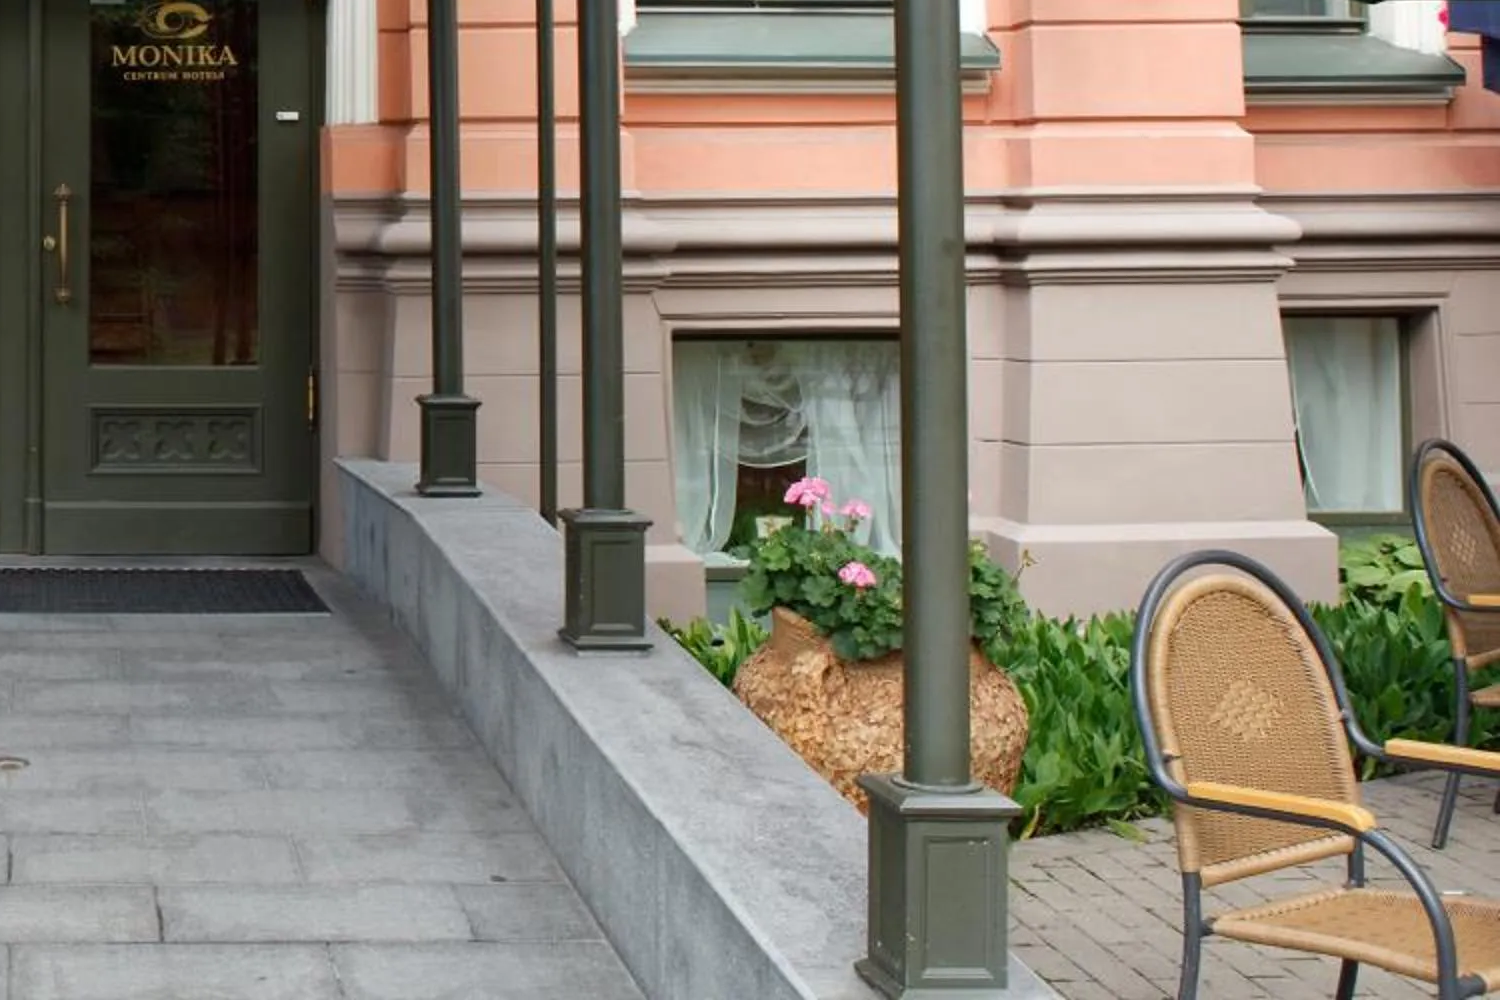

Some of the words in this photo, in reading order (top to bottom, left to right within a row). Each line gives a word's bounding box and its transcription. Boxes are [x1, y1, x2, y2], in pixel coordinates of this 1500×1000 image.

[110, 45, 239, 67] MONIKA
[123, 71, 178, 81] CENTRUM
[182, 71, 225, 80] HOTELS
